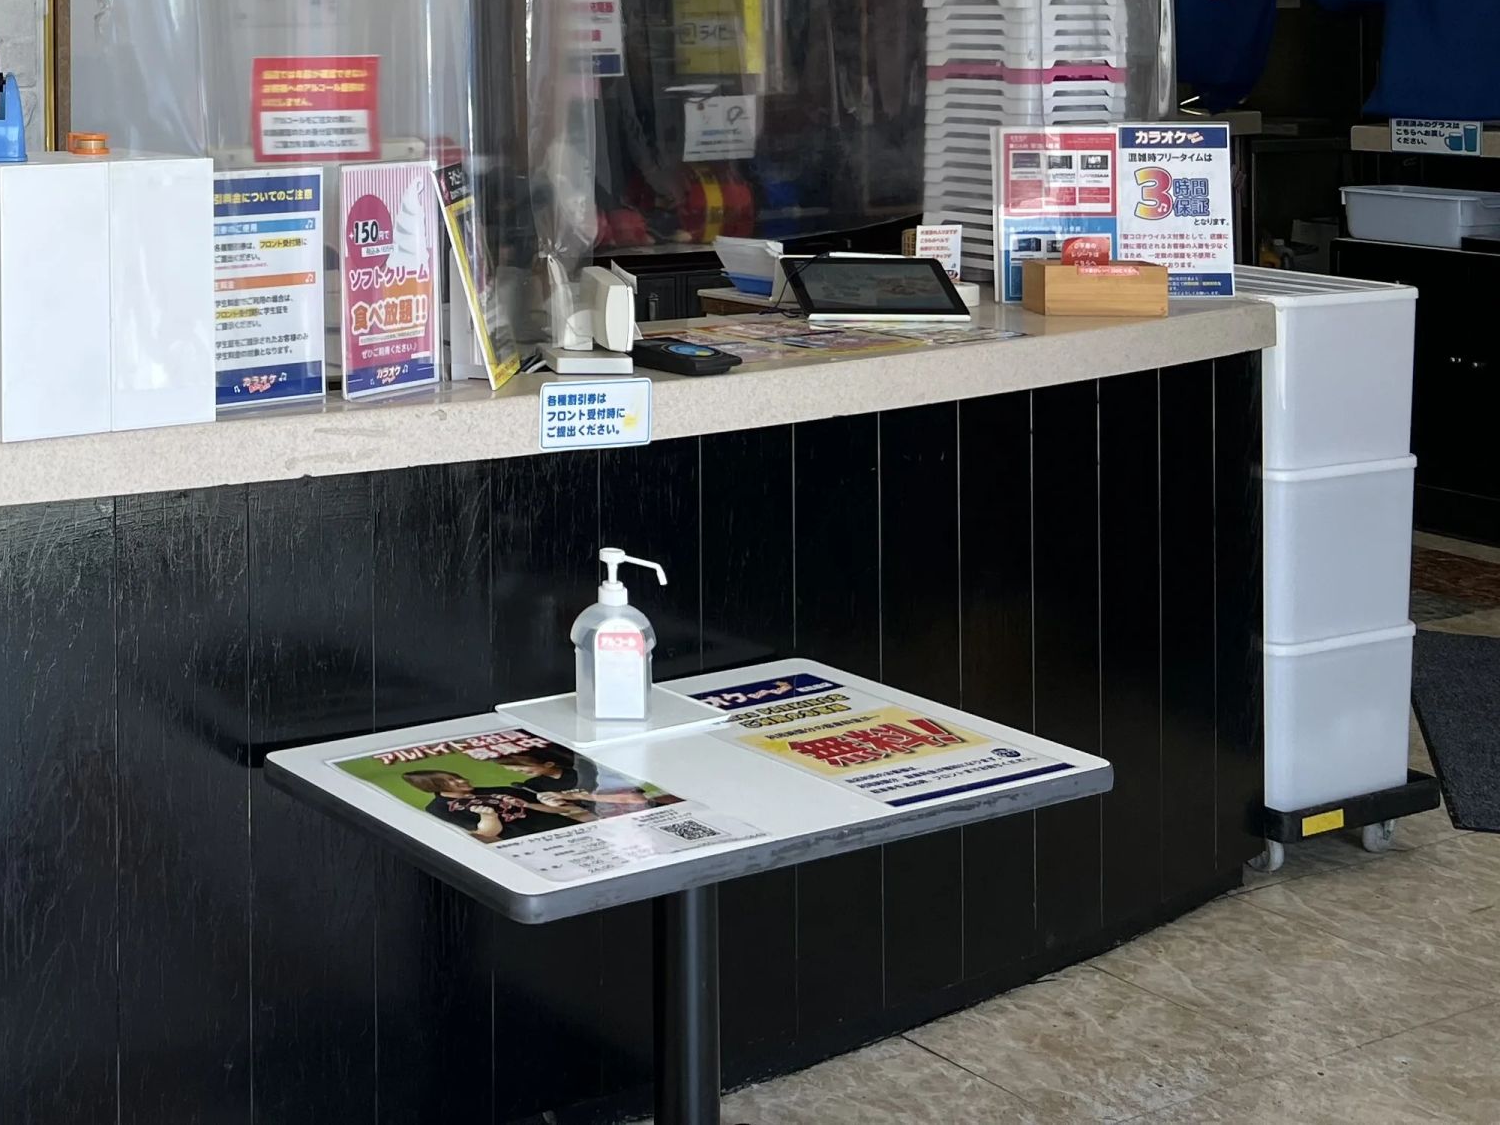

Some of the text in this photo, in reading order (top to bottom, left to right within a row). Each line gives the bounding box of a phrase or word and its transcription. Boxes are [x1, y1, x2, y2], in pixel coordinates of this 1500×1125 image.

[1135, 131, 1187, 144] カラオケ
[1396, 137, 1428, 145] ください。
[1128, 153, 1213, 162] 混雑時フリータイムは
[1134, 166, 1173, 220] 3
[1173, 178, 1209, 197] 時間
[1174, 197, 1210, 216] 保証
[349, 263, 430, 291] ソフトクリーム
[547, 393, 607, 407] 各種割引券は
[547, 408, 626, 422] フロント受付時に
[547, 424, 620, 438] ご提出ください。
